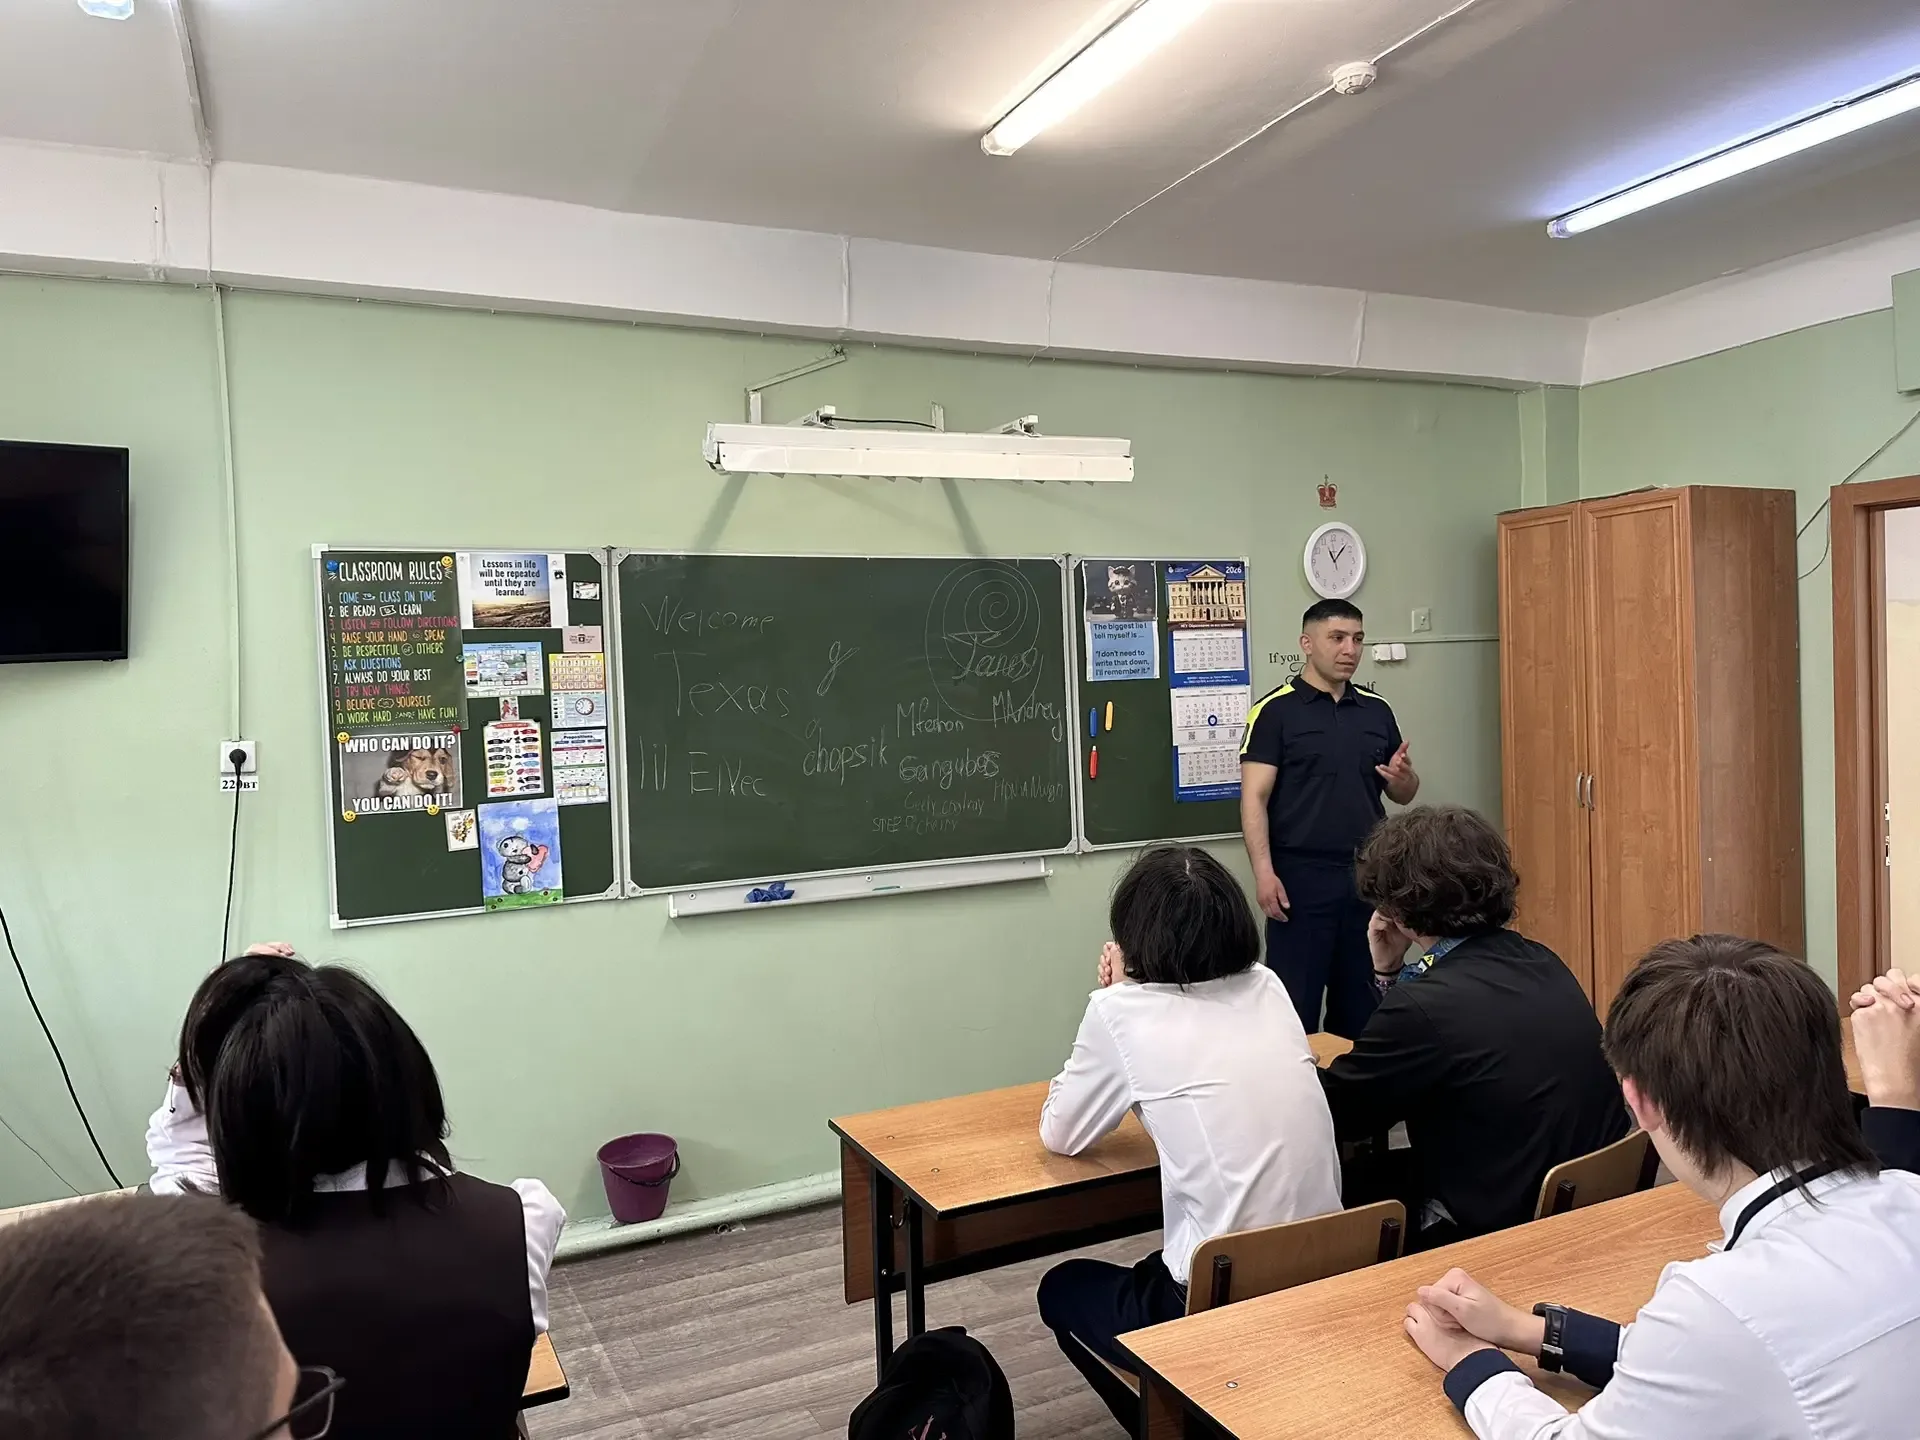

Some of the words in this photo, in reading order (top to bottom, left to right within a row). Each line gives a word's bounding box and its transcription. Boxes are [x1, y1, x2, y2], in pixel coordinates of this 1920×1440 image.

[482, 560, 512, 568] Lessons
[514, 560, 522, 568] in
[524, 560, 536, 568] life
[339, 561, 403, 581] CLASSROOM
[409, 561, 442, 580] RULES
[479, 569, 493, 577] will
[495, 569, 505, 577] be
[507, 570, 540, 580] repeated
[505, 579, 521, 588] they
[339, 592, 360, 603] COME
[380, 591, 400, 602] CLASS
[404, 591, 415, 602] ON
[420, 590, 436, 602] TIME
[329, 606, 335, 617] 2.
[340, 606, 349, 617] BE
[353, 605, 376, 617] READY
[400, 604, 422, 616] LEARN
[641, 595, 774, 636] Welcome
[341, 619, 367, 630] LISTEN
[384, 618, 413, 629] FOLLOW
[418, 616, 458, 627] DIRECTIONS
[1108, 622, 1134, 631] biggest
[342, 632, 361, 643] RAISE
[365, 631, 384, 643] YOUR
[388, 631, 408, 642] HAND
[424, 630, 445, 641] SPEAK
[342, 646, 352, 657] BE
[356, 644, 400, 657] RESPECTFUL
[416, 642, 444, 654] OTHERS
[344, 659, 356, 670] ASK
[361, 657, 402, 669] QUESTIONS
[1269, 653, 1279, 663] If
[1280, 655, 1300, 665] you
[333, 674, 340, 685] 7.
[344, 671, 373, 683] ALWAYS
[377, 671, 388, 682] DO
[391, 670, 410, 681] YOUR
[414, 669, 432, 680] BEST
[654, 648, 790, 718] Texas
[346, 686, 359, 697] TRY
[362, 685, 380, 696] NEW
[385, 684, 411, 695] THINGS
[335, 700, 342, 711] 9.
[346, 698, 375, 710] BELIEVE
[396, 695, 432, 707] YOURSELF
[347, 712, 369, 724] WORK
[373, 711, 392, 722] HARD
[418, 709, 436, 720] HAVE
[440, 707, 458, 719] FUN!
[345, 738, 378, 753] WHO
[382, 737, 408, 751] CAN
[412, 736, 431, 750] DO
[434, 734, 456, 749] IT?
[352, 798, 380, 812] YOU
[383, 795, 410, 810] CAN
[413, 794, 432, 808] DO
[435, 793, 453, 807] IT!
